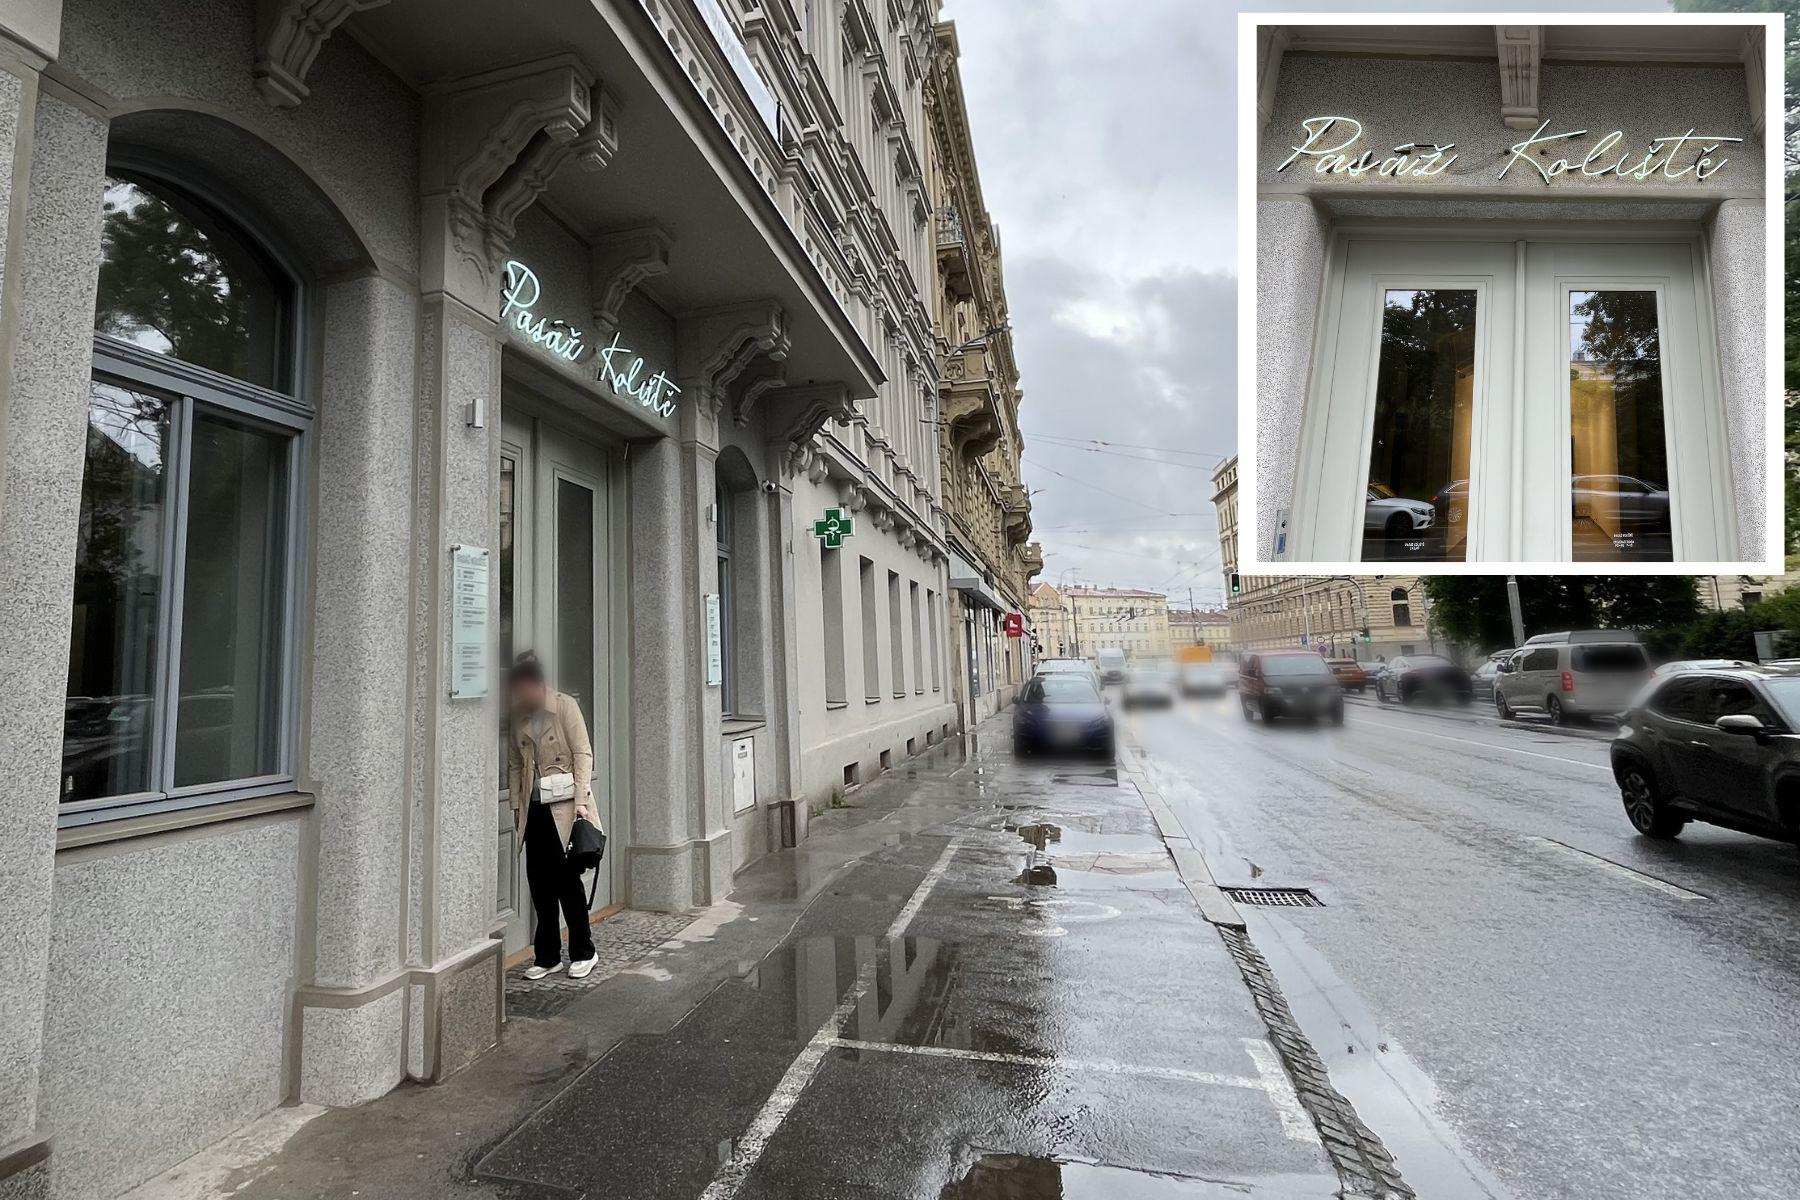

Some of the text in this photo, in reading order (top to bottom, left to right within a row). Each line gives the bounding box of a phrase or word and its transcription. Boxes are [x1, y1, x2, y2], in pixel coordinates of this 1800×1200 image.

[1277, 116, 1743, 185] Pasáž Koliště
[501, 260, 682, 417] Pasáž Koliště
